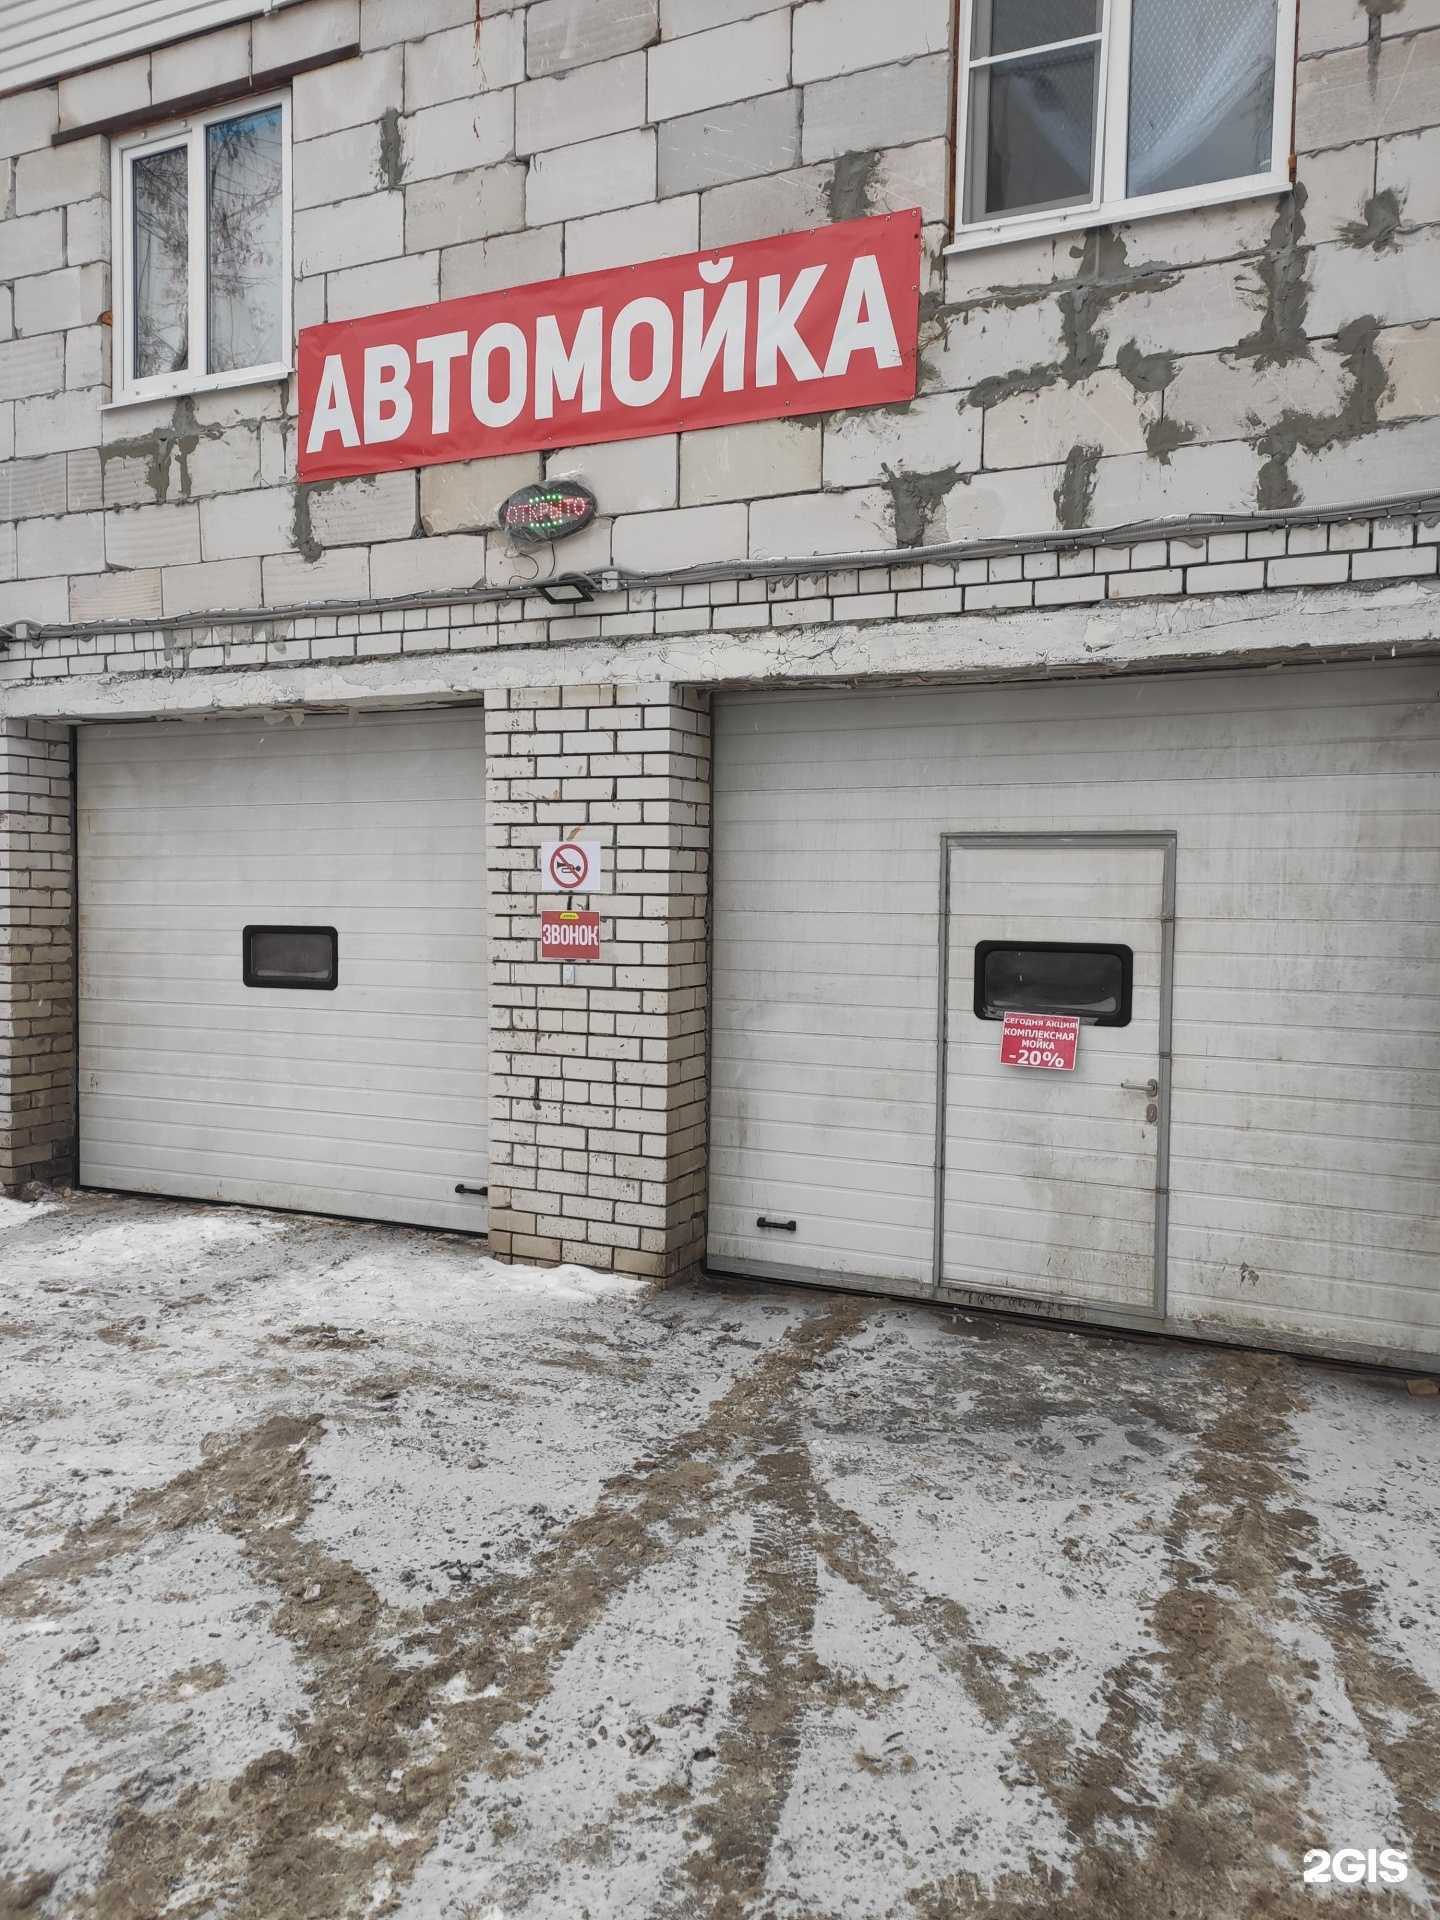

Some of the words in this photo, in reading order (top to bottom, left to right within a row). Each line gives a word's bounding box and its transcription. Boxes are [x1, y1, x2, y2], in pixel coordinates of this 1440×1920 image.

[306, 255, 903, 453] АВТОМОЙКА
[506, 497, 585, 524] ОТКРЫТО
[542, 923, 599, 946] ЗВОНОК
[1004, 1017, 1043, 1027] СЕГОДНЯ
[1004, 1027, 1075, 1041] КОМПЛЕКСНАЯ
[1021, 1038, 1055, 1050] МОЙКА
[1009, 1050, 1065, 1068] -20%
